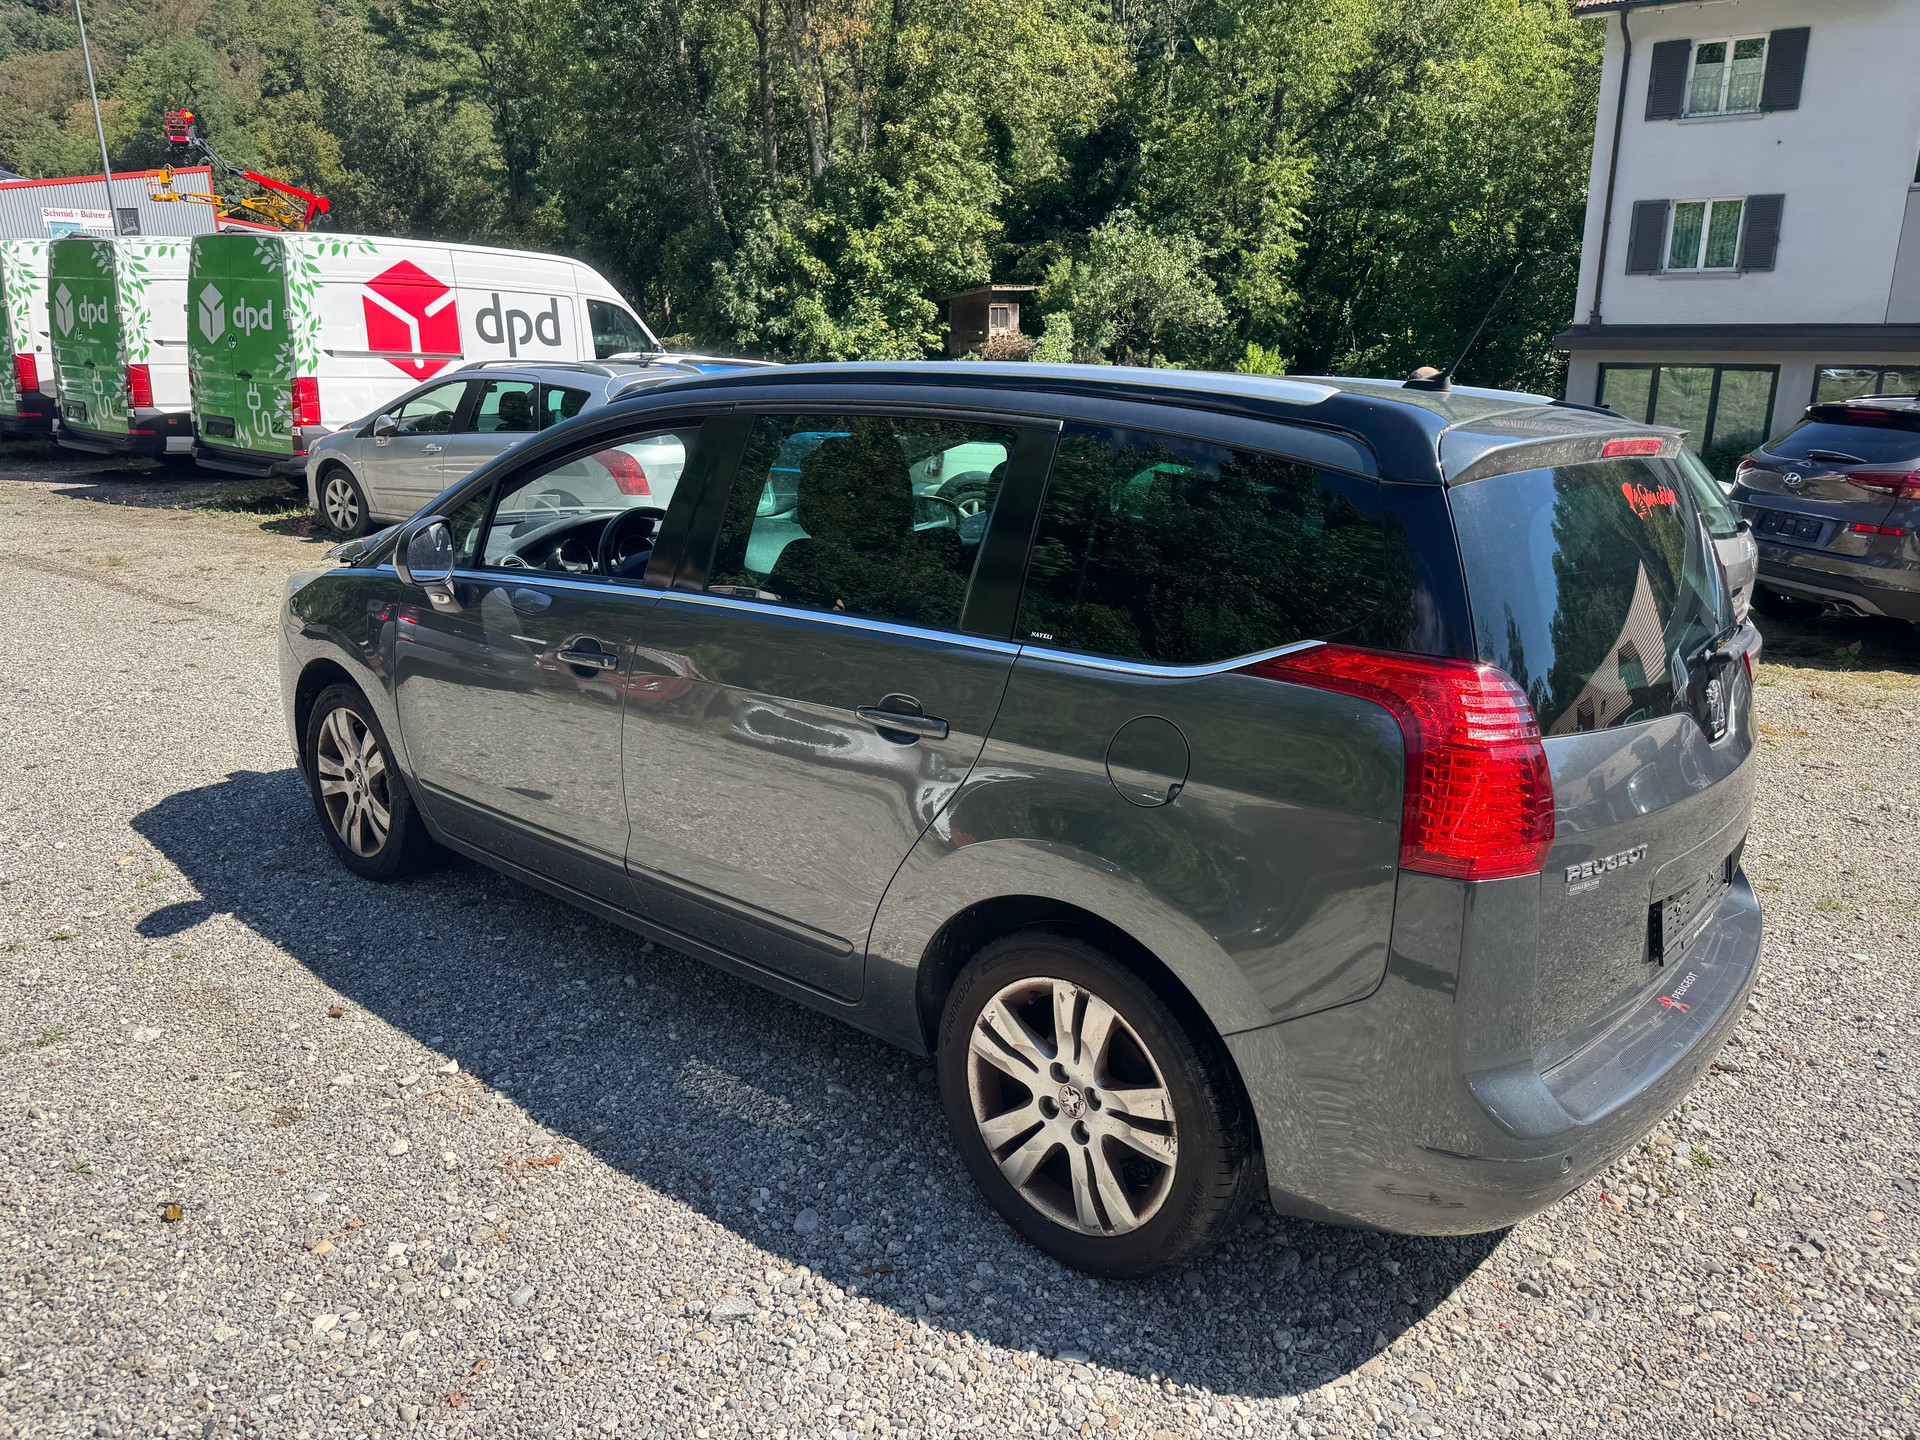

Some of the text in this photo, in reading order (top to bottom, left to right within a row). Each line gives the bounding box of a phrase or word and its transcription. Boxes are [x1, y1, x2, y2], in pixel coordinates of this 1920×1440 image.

[43, 208, 74, 218] Schmid
[80, 210, 106, 219] Bührer
[79, 295, 108, 329] dpd
[233, 298, 272, 336] dpd
[475, 292, 562, 358] dpd
[113, 404, 121, 413] 24
[272, 421, 285, 434] 22
[1565, 843, 1648, 883] PEUGEOT
[1671, 971, 1699, 1000] PEUGEOT
